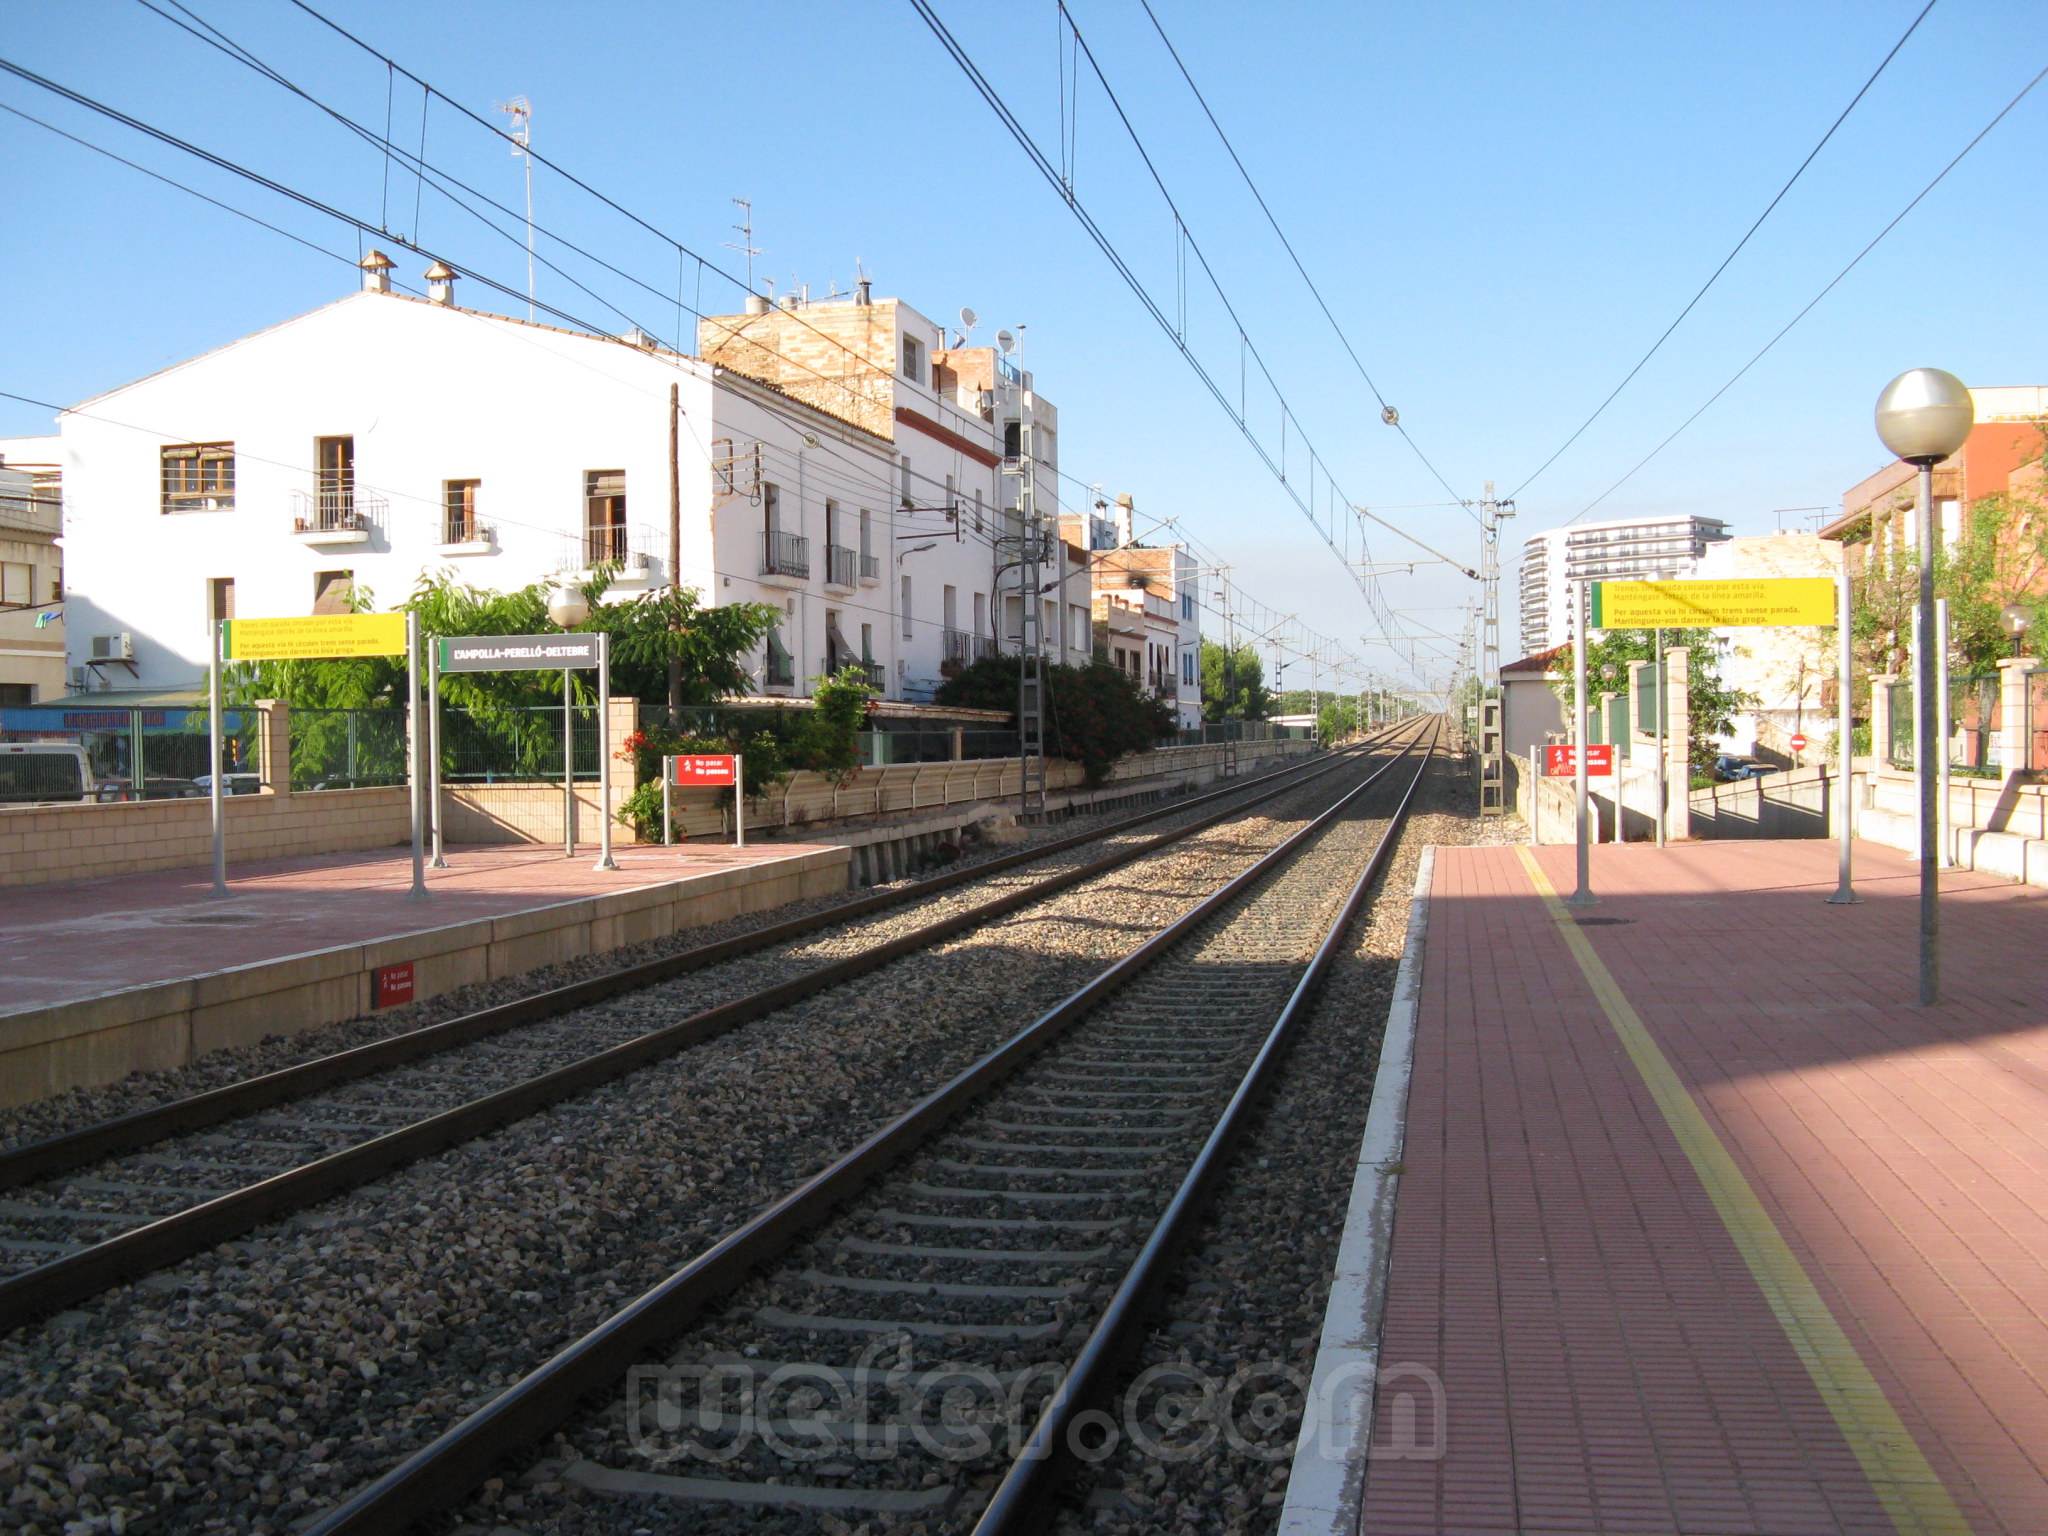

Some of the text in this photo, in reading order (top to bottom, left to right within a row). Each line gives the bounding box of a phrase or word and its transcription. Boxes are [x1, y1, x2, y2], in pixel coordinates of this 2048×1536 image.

[1655, 584, 1681, 592] parada
[1614, 593, 1660, 601] Manténgase
[1663, 592, 1688, 600] detrás
[1733, 591, 1766, 599] amarilla.
[1630, 608, 1661, 616] aquesta
[1770, 606, 1800, 614] parada.
[1614, 617, 1678, 626] Mantingueu-vos
[1681, 616, 1712, 624] darrere
[1742, 616, 1768, 624] groga.
[454, 645, 590, 660] L'AMPOLLA-PERELLÓ-DELTEBRE
